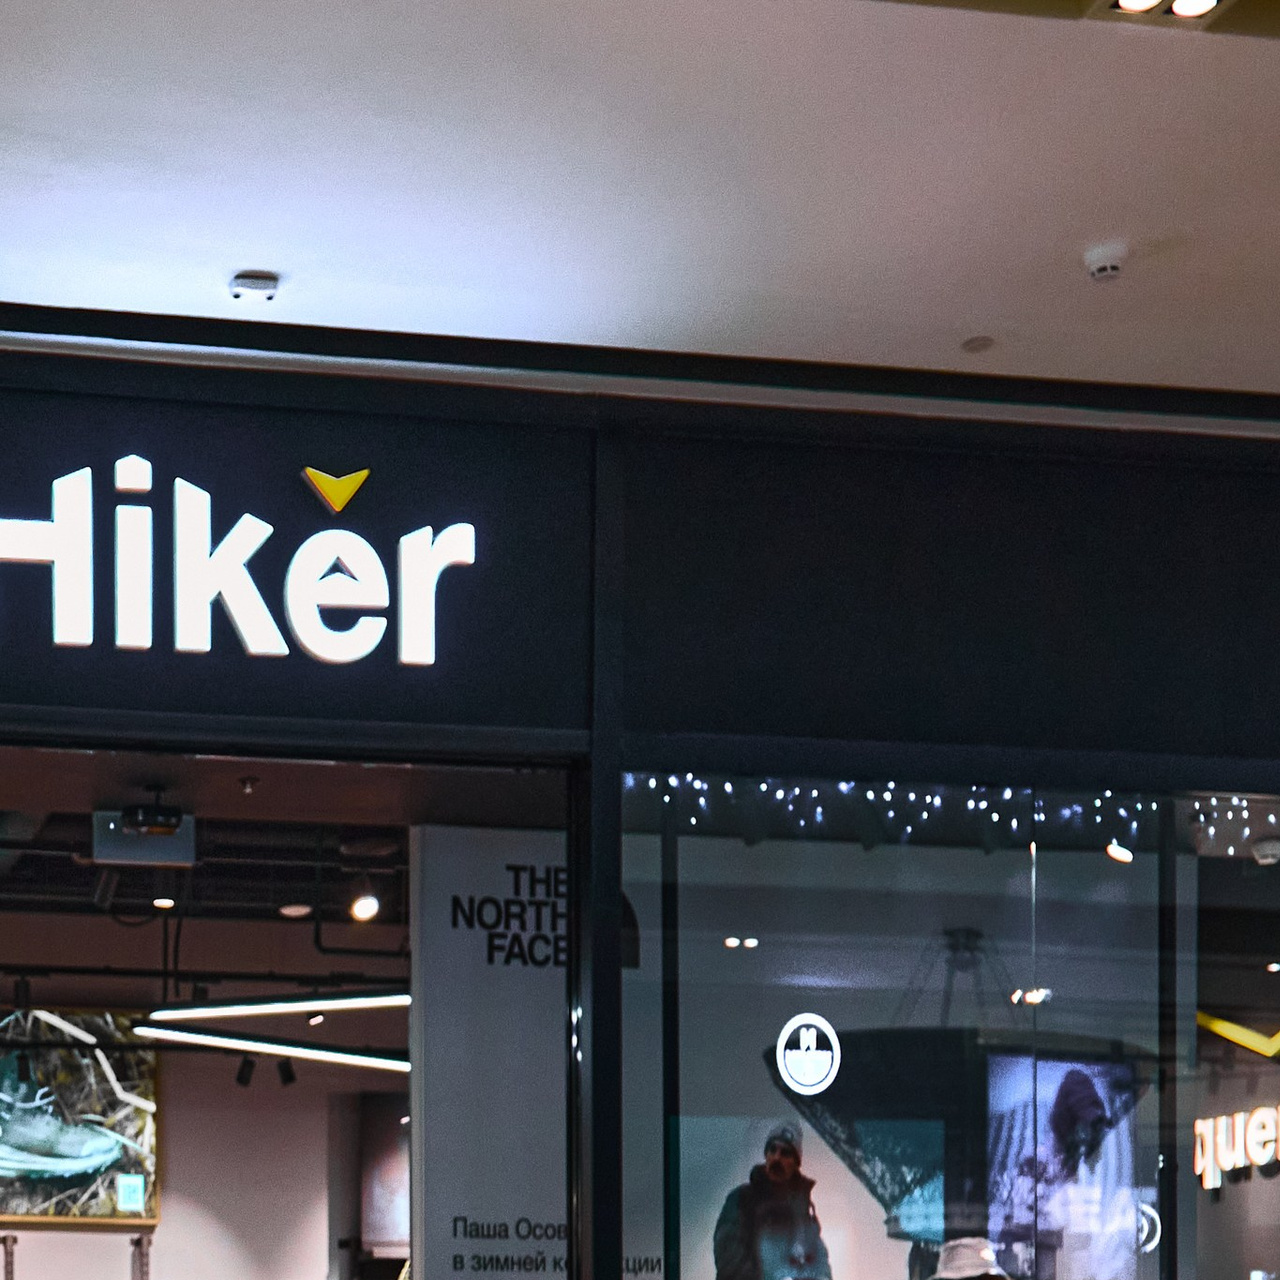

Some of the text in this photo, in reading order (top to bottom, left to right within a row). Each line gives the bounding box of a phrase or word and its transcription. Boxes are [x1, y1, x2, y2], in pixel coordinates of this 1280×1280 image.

[505, 864, 569, 898] THE
[451, 894, 569, 932] NORTH
[486, 931, 569, 967] FACE
[453, 1216, 569, 1241] Паша Осов
[453, 1255, 465, 1272] в
[471, 1253, 547, 1272] зимней
